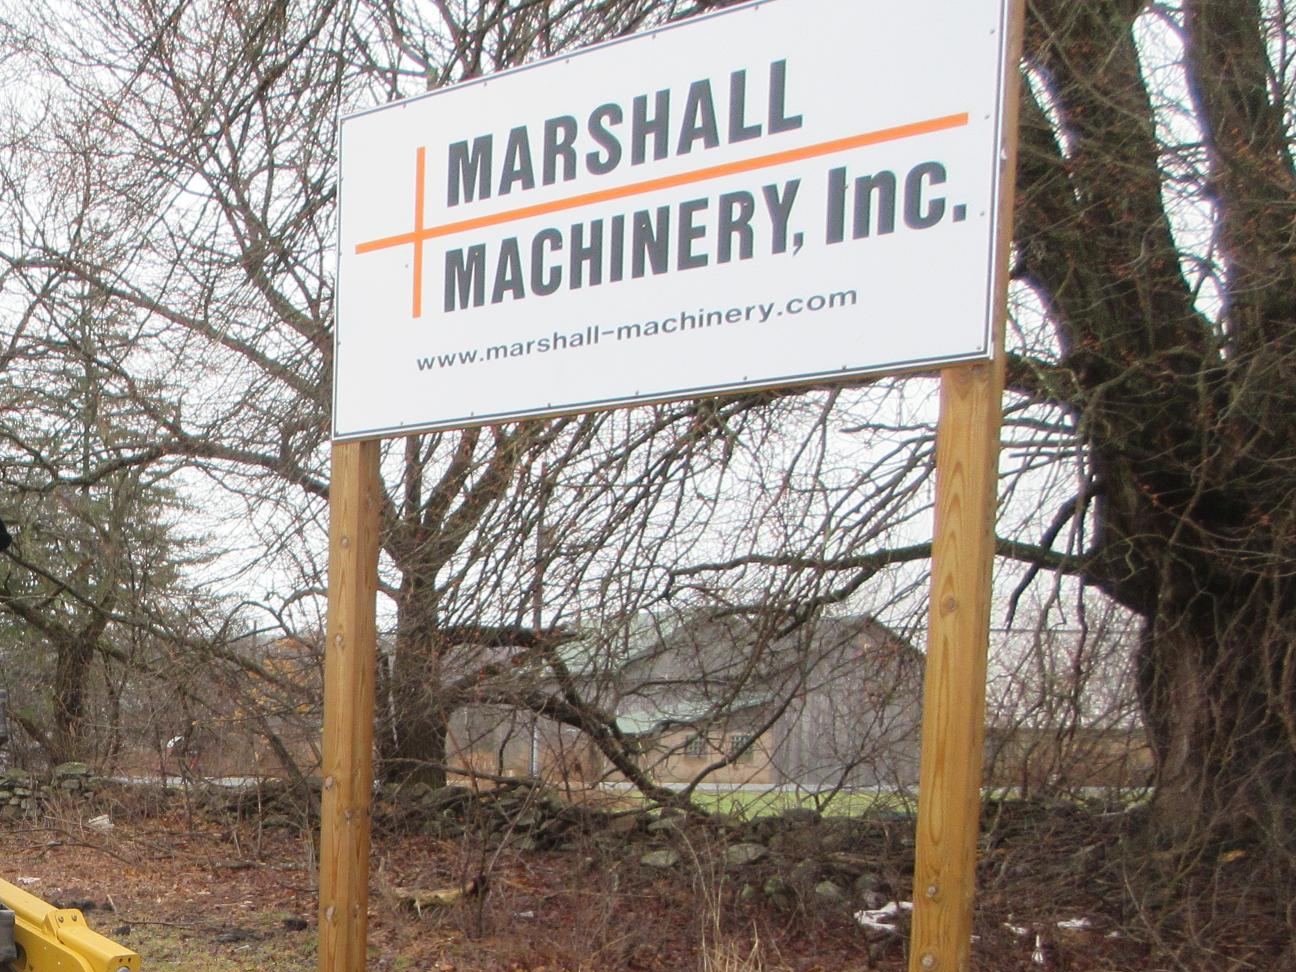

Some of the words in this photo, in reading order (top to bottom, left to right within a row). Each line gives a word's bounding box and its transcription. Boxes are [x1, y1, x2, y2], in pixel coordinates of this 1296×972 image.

[447, 59, 803, 207] MARSHALL
[443, 179, 805, 314] MACHINERY,
[825, 161, 967, 245] Inc.
[417, 289, 857, 371] www.marshall-machinery.com
